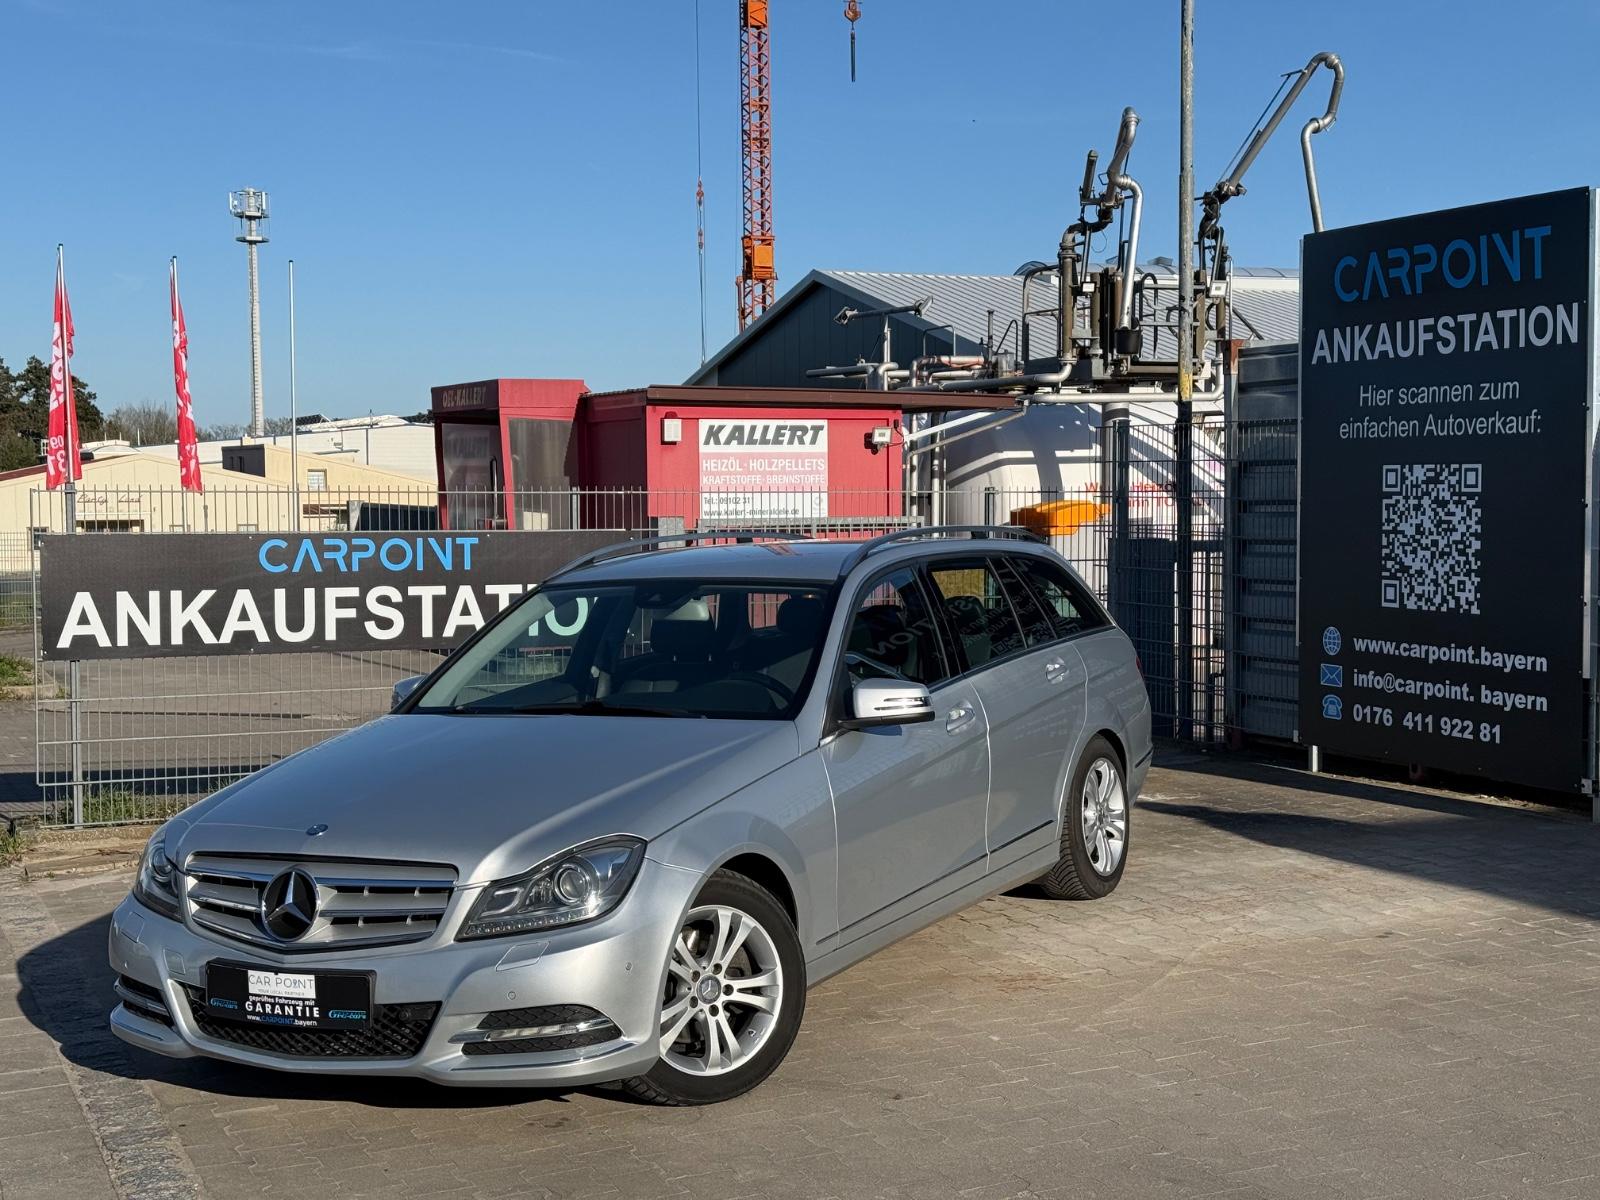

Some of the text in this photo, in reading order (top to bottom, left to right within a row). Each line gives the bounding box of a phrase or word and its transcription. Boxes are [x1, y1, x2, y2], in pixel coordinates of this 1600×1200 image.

[1334, 226, 1551, 302] CARPOINT
[1311, 302, 1579, 365] ANKAUFSTATION
[1360, 380, 1520, 407] Hier scannen zum
[703, 425, 824, 446] KALLERT
[1339, 408, 1542, 439] einfachen Autoverkauf:
[702, 456, 825, 472] HEIZÖL HOLZPELLETS
[702, 474, 825, 485] KRAFTSTOFFE BRENNSTOFFE
[258, 537, 479, 573] CARPOINT
[56, 584, 598, 649] ANKAUFSTATO
[1353, 637, 1548, 673] www.carpoint.bayern
[1480, 685, 1548, 712] bayern
[1353, 703, 1501, 744] 0176 411 922 81
[248, 974, 271, 986] CAR
[245, 1001, 320, 1018] GARANTIE
[247, 1014, 318, 1027] www.CARPOINT.bayern
